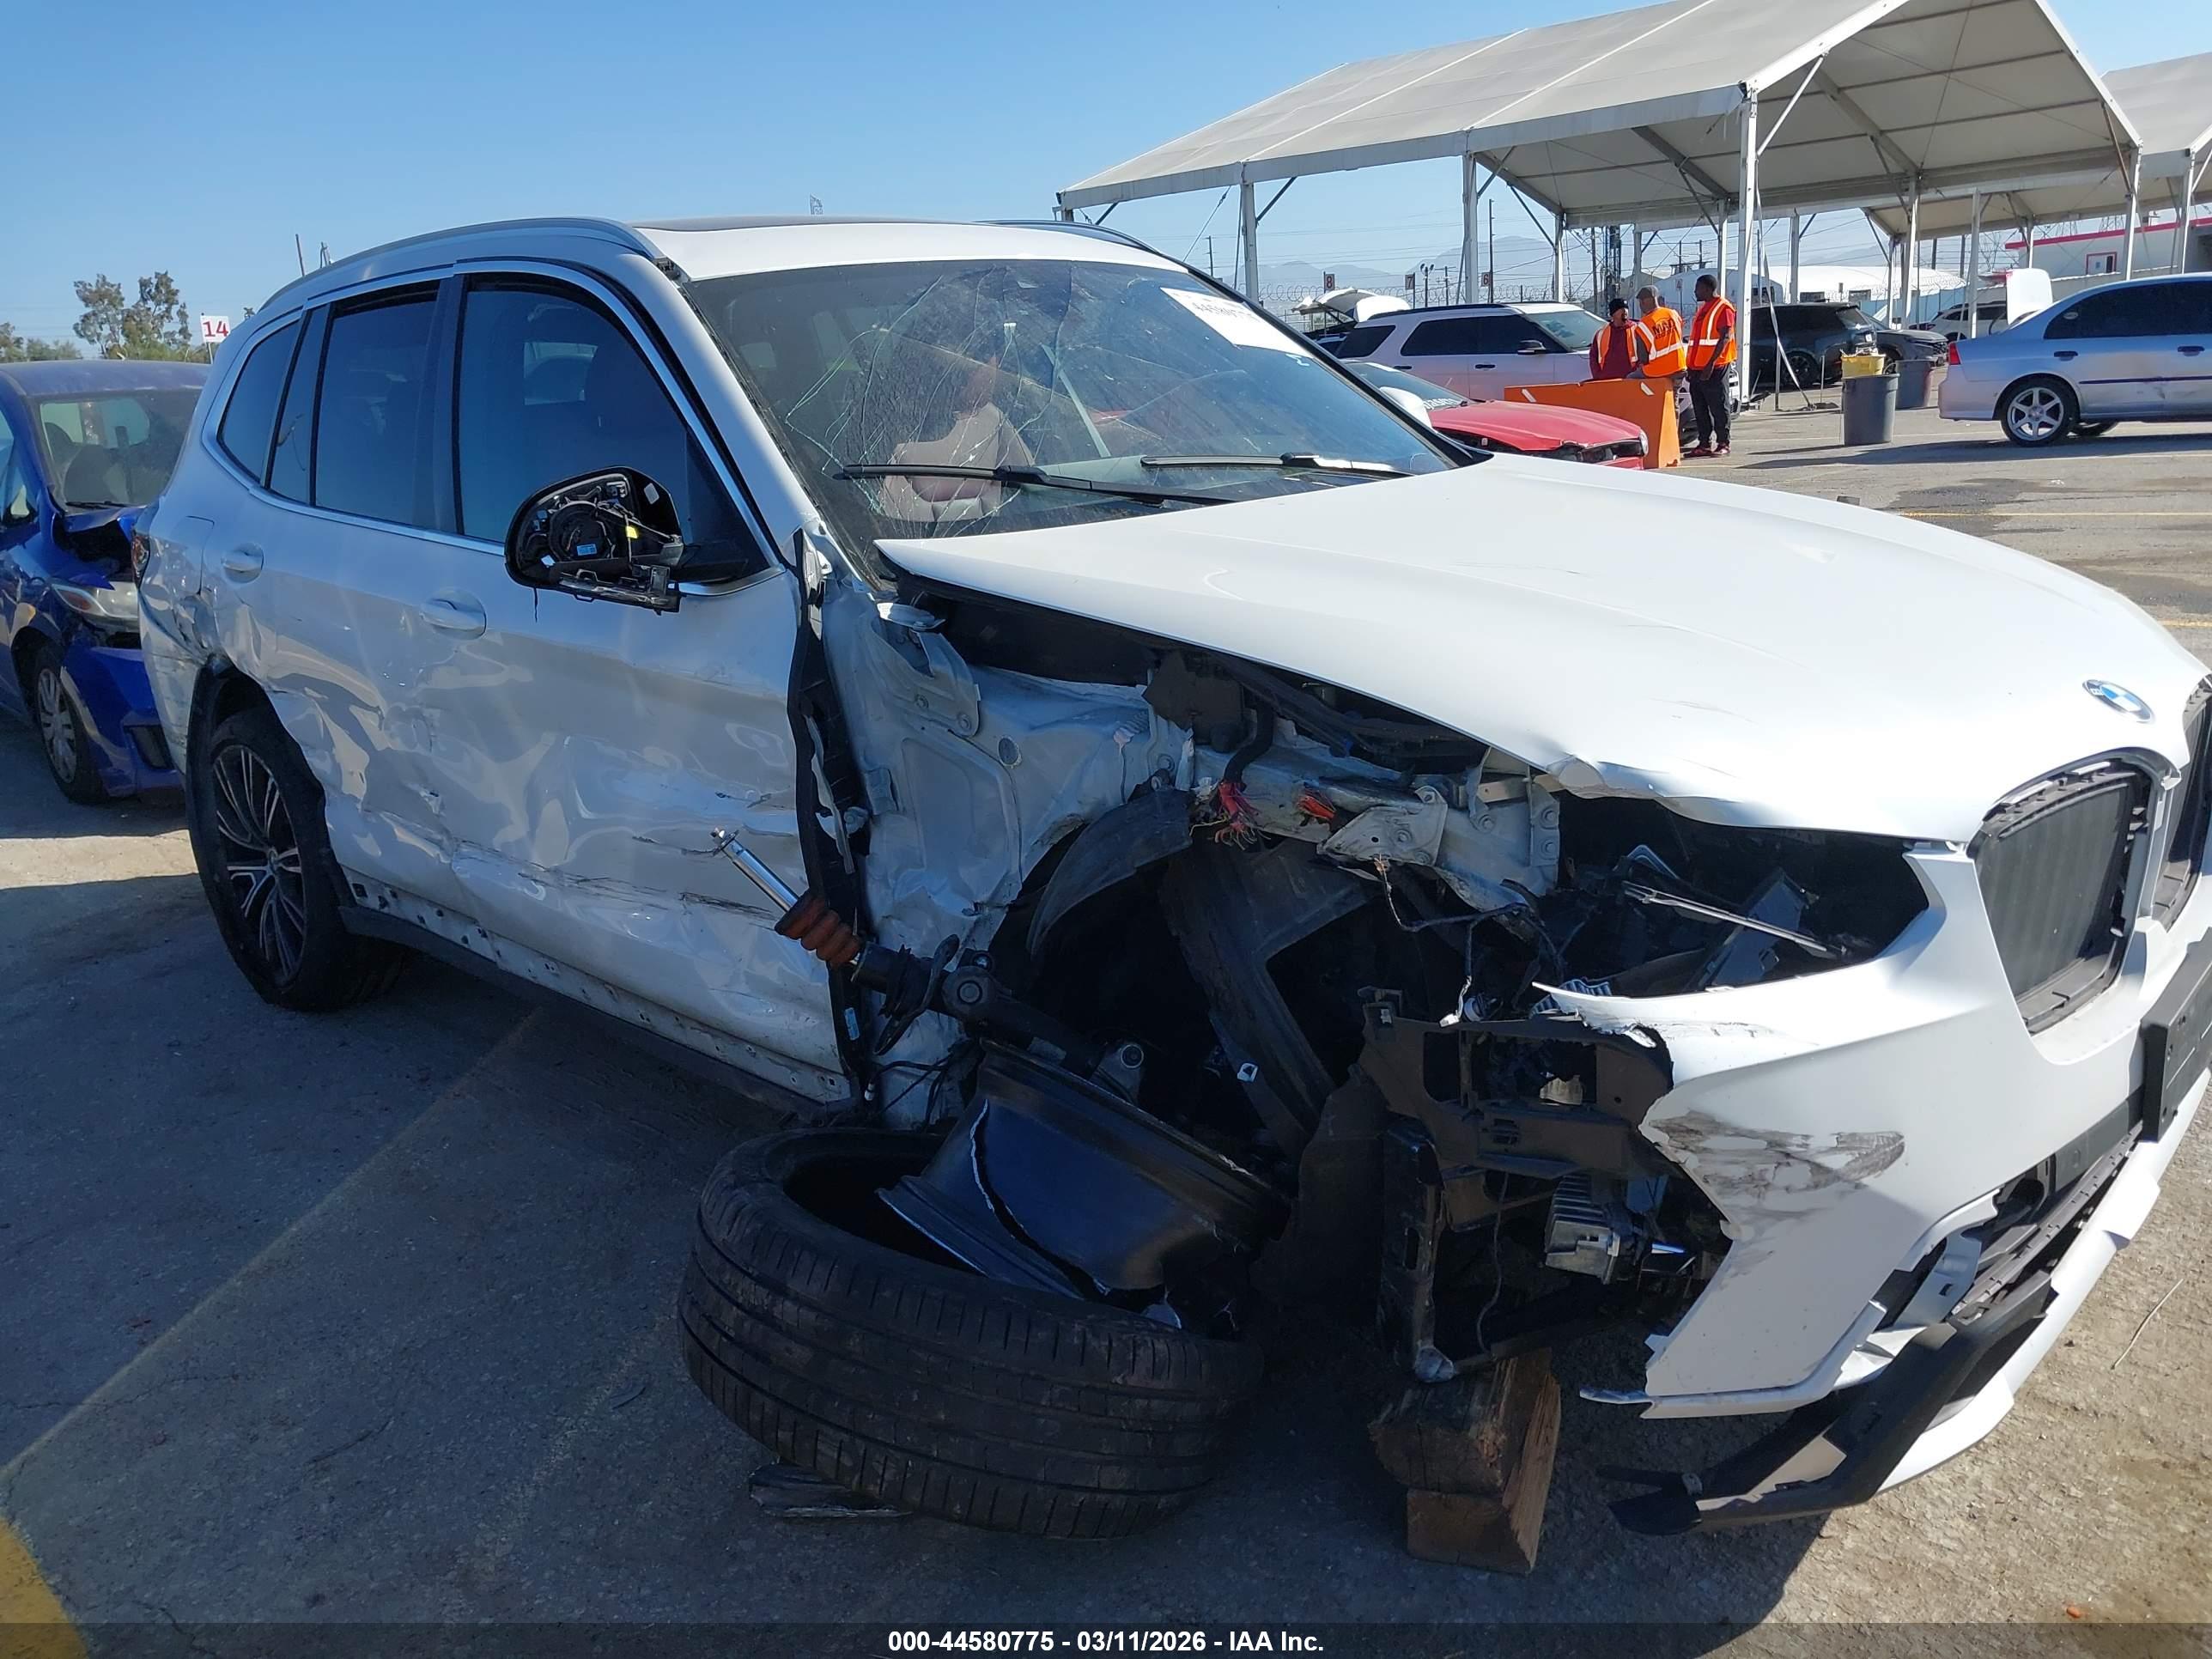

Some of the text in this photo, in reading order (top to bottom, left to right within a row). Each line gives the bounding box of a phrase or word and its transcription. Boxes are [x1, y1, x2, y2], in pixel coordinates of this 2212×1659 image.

[1326, 276, 1333, 289] 8
[1407, 276, 1414, 289] 7
[1483, 273, 1490, 285] 6
[202, 319, 229, 337] 14
